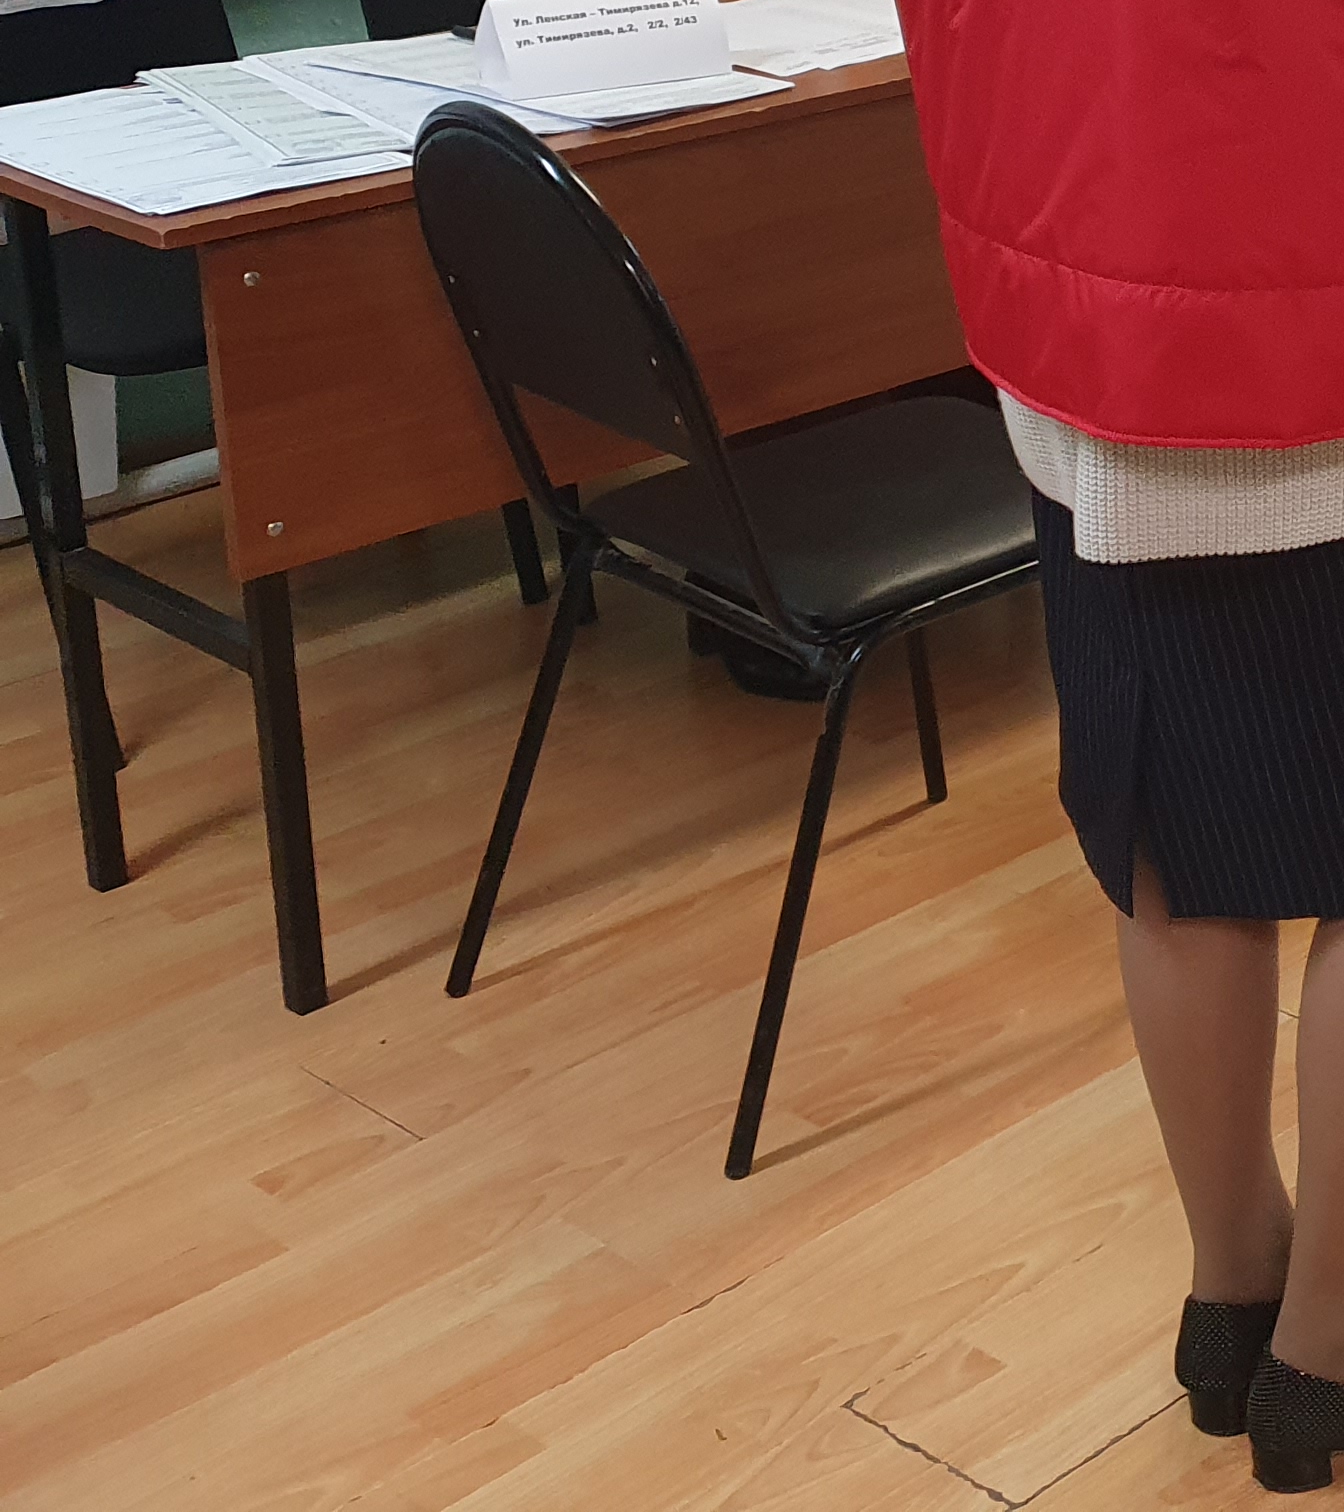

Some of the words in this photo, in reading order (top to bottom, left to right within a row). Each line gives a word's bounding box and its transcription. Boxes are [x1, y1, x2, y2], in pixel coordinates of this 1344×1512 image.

[513, 18, 533, 27] Ул.
[535, 11, 587, 24] Ленская
[597, 1, 670, 17] Тимирязева
[516, 38, 535, 48] ул.
[537, 27, 614, 44] Тимирязева,
[617, 23, 638, 35] д.2,
[647, 19, 669, 29] 2/2,
[673, 15, 698, 26] 2/43
